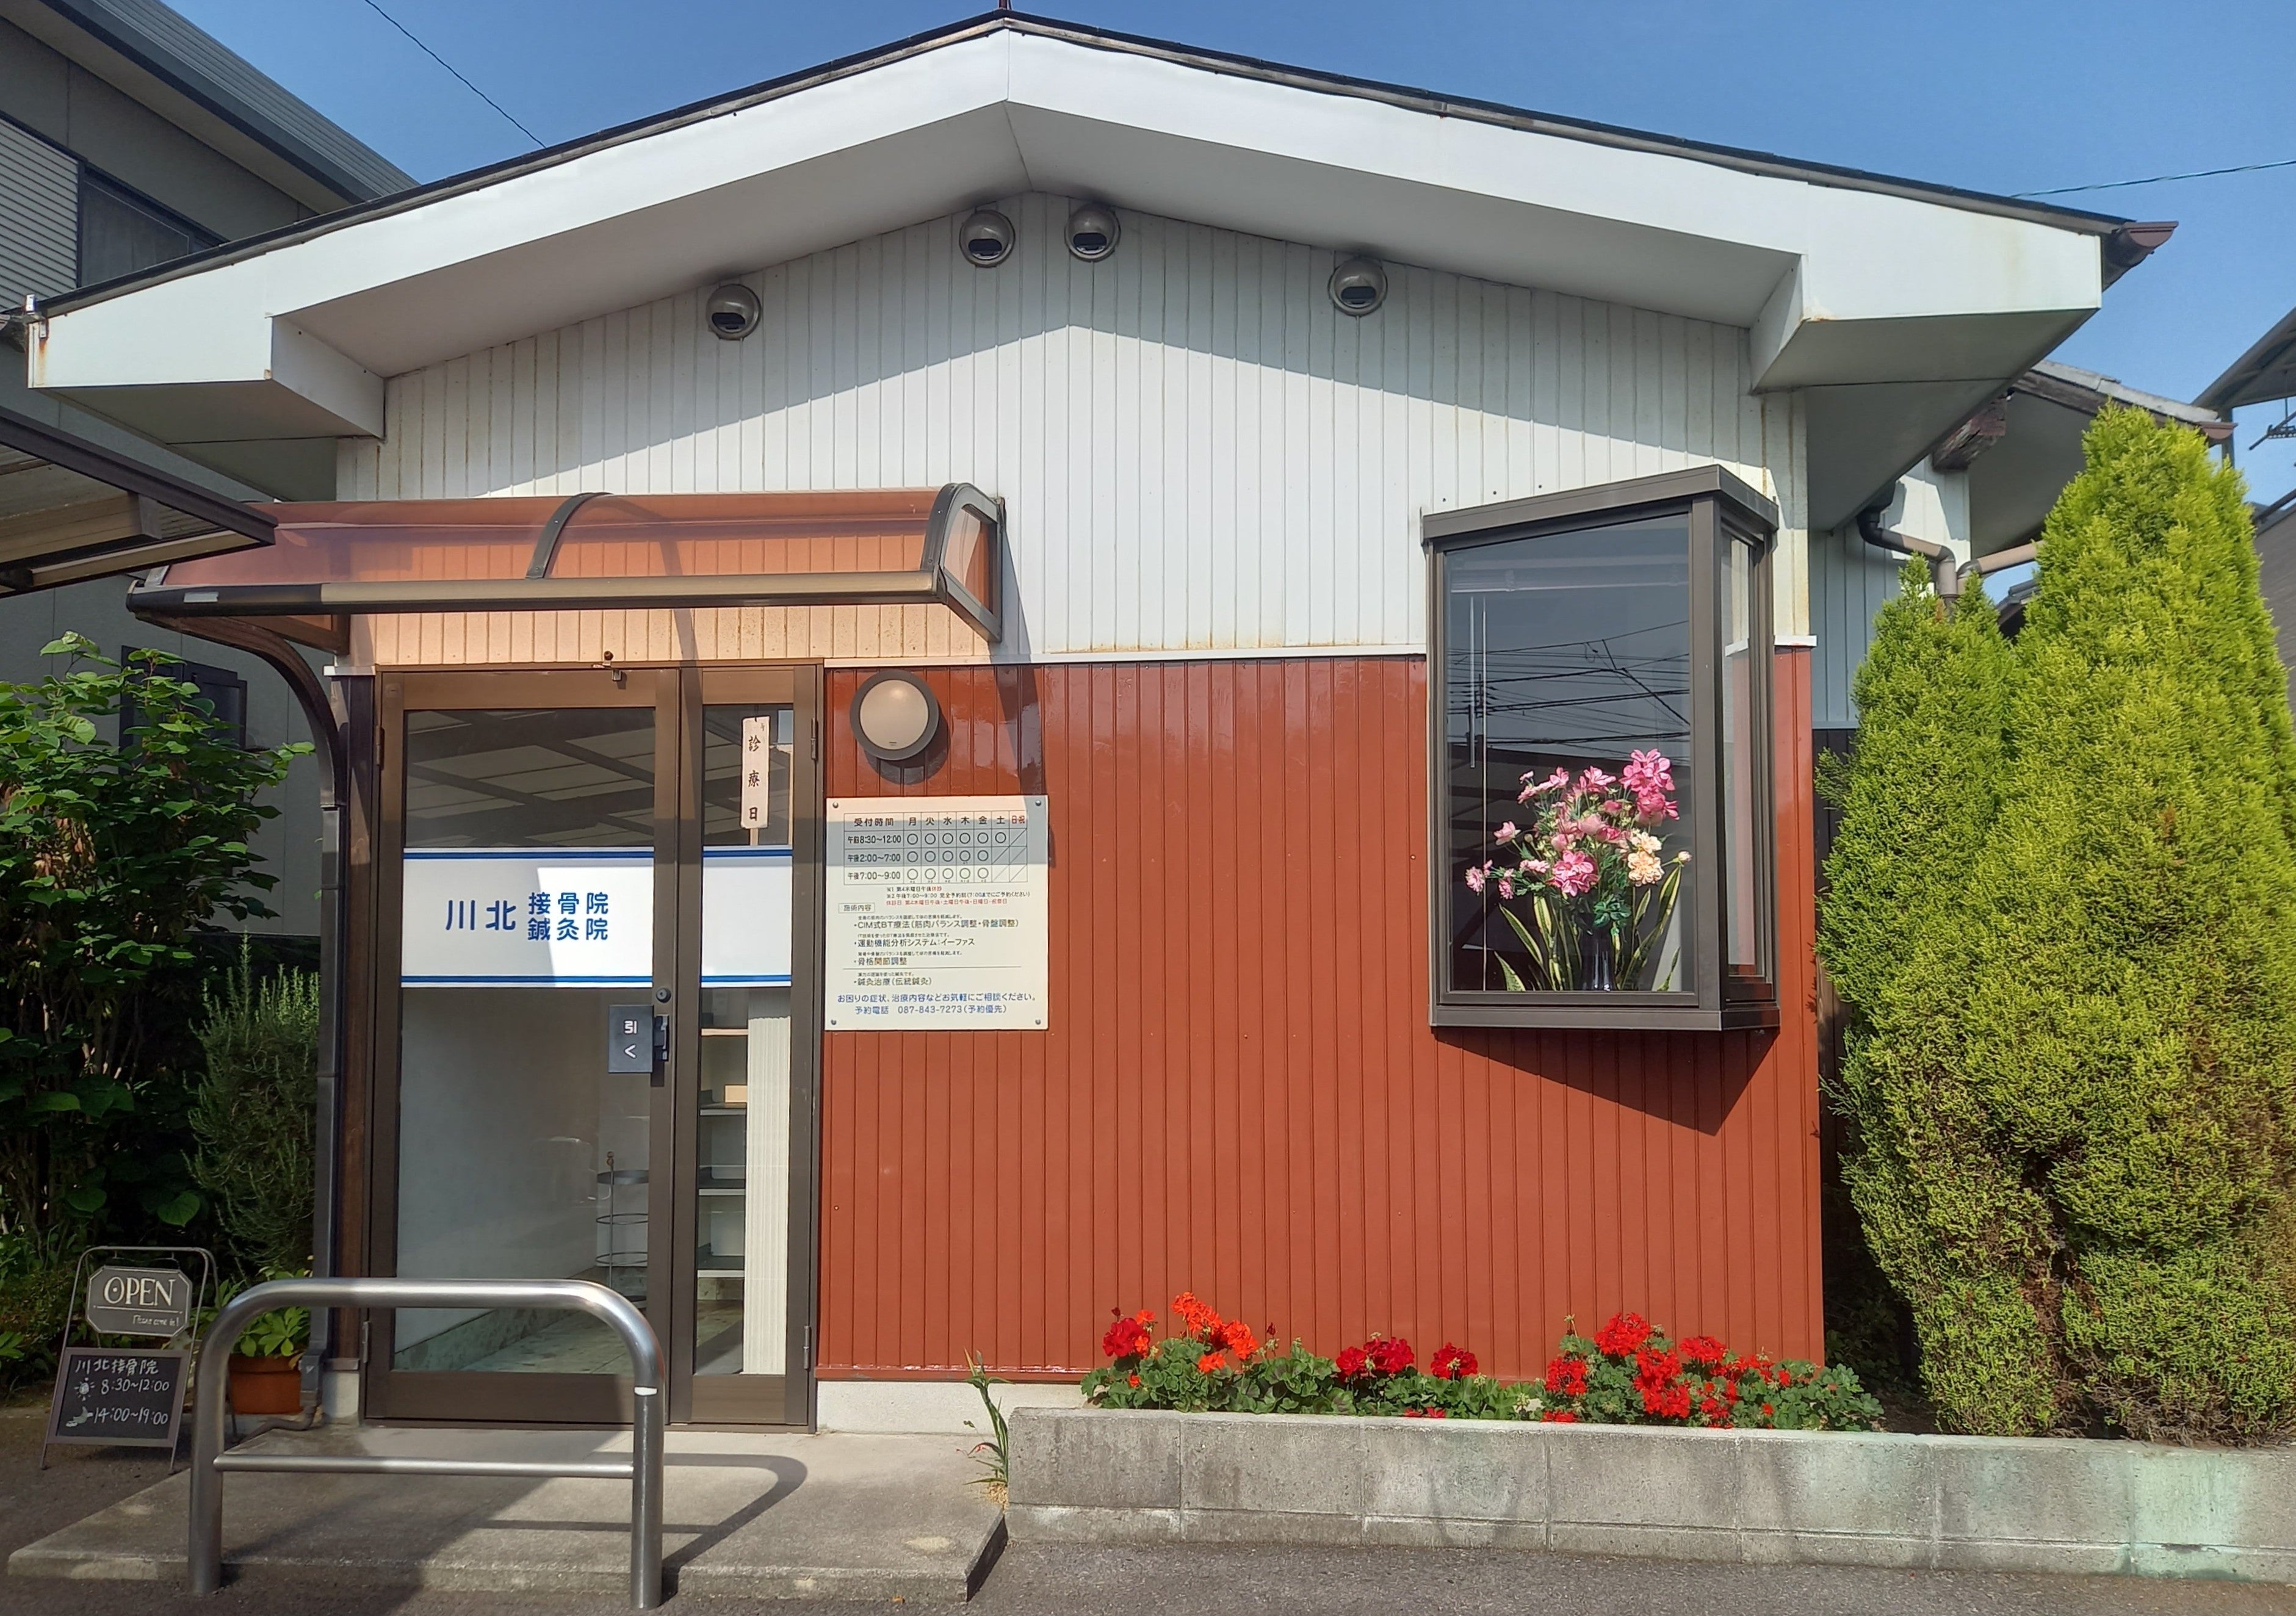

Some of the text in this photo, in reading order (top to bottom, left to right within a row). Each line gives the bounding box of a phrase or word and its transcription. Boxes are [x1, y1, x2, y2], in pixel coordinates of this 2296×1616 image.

[748, 735, 761, 821] 診療日
[854, 817, 894, 826] 受付時間
[908, 817, 917, 826] 月
[925, 817, 935, 825] 火
[978, 816, 987, 824] 金
[528, 892, 608, 915] 接骨院
[446, 899, 517, 931] 川北
[527, 918, 608, 940] 鍼灸院
[855, 1006, 889, 1014] 予約電話
[623, 1019, 637, 1058] 引く
[103, 1276, 176, 1306] OPEN
[75, 1358, 159, 1376] 川北接骨院
[101, 1378, 170, 1394] 8:30~12:00
[93, 1407, 168, 1425] 14:00~19:00
